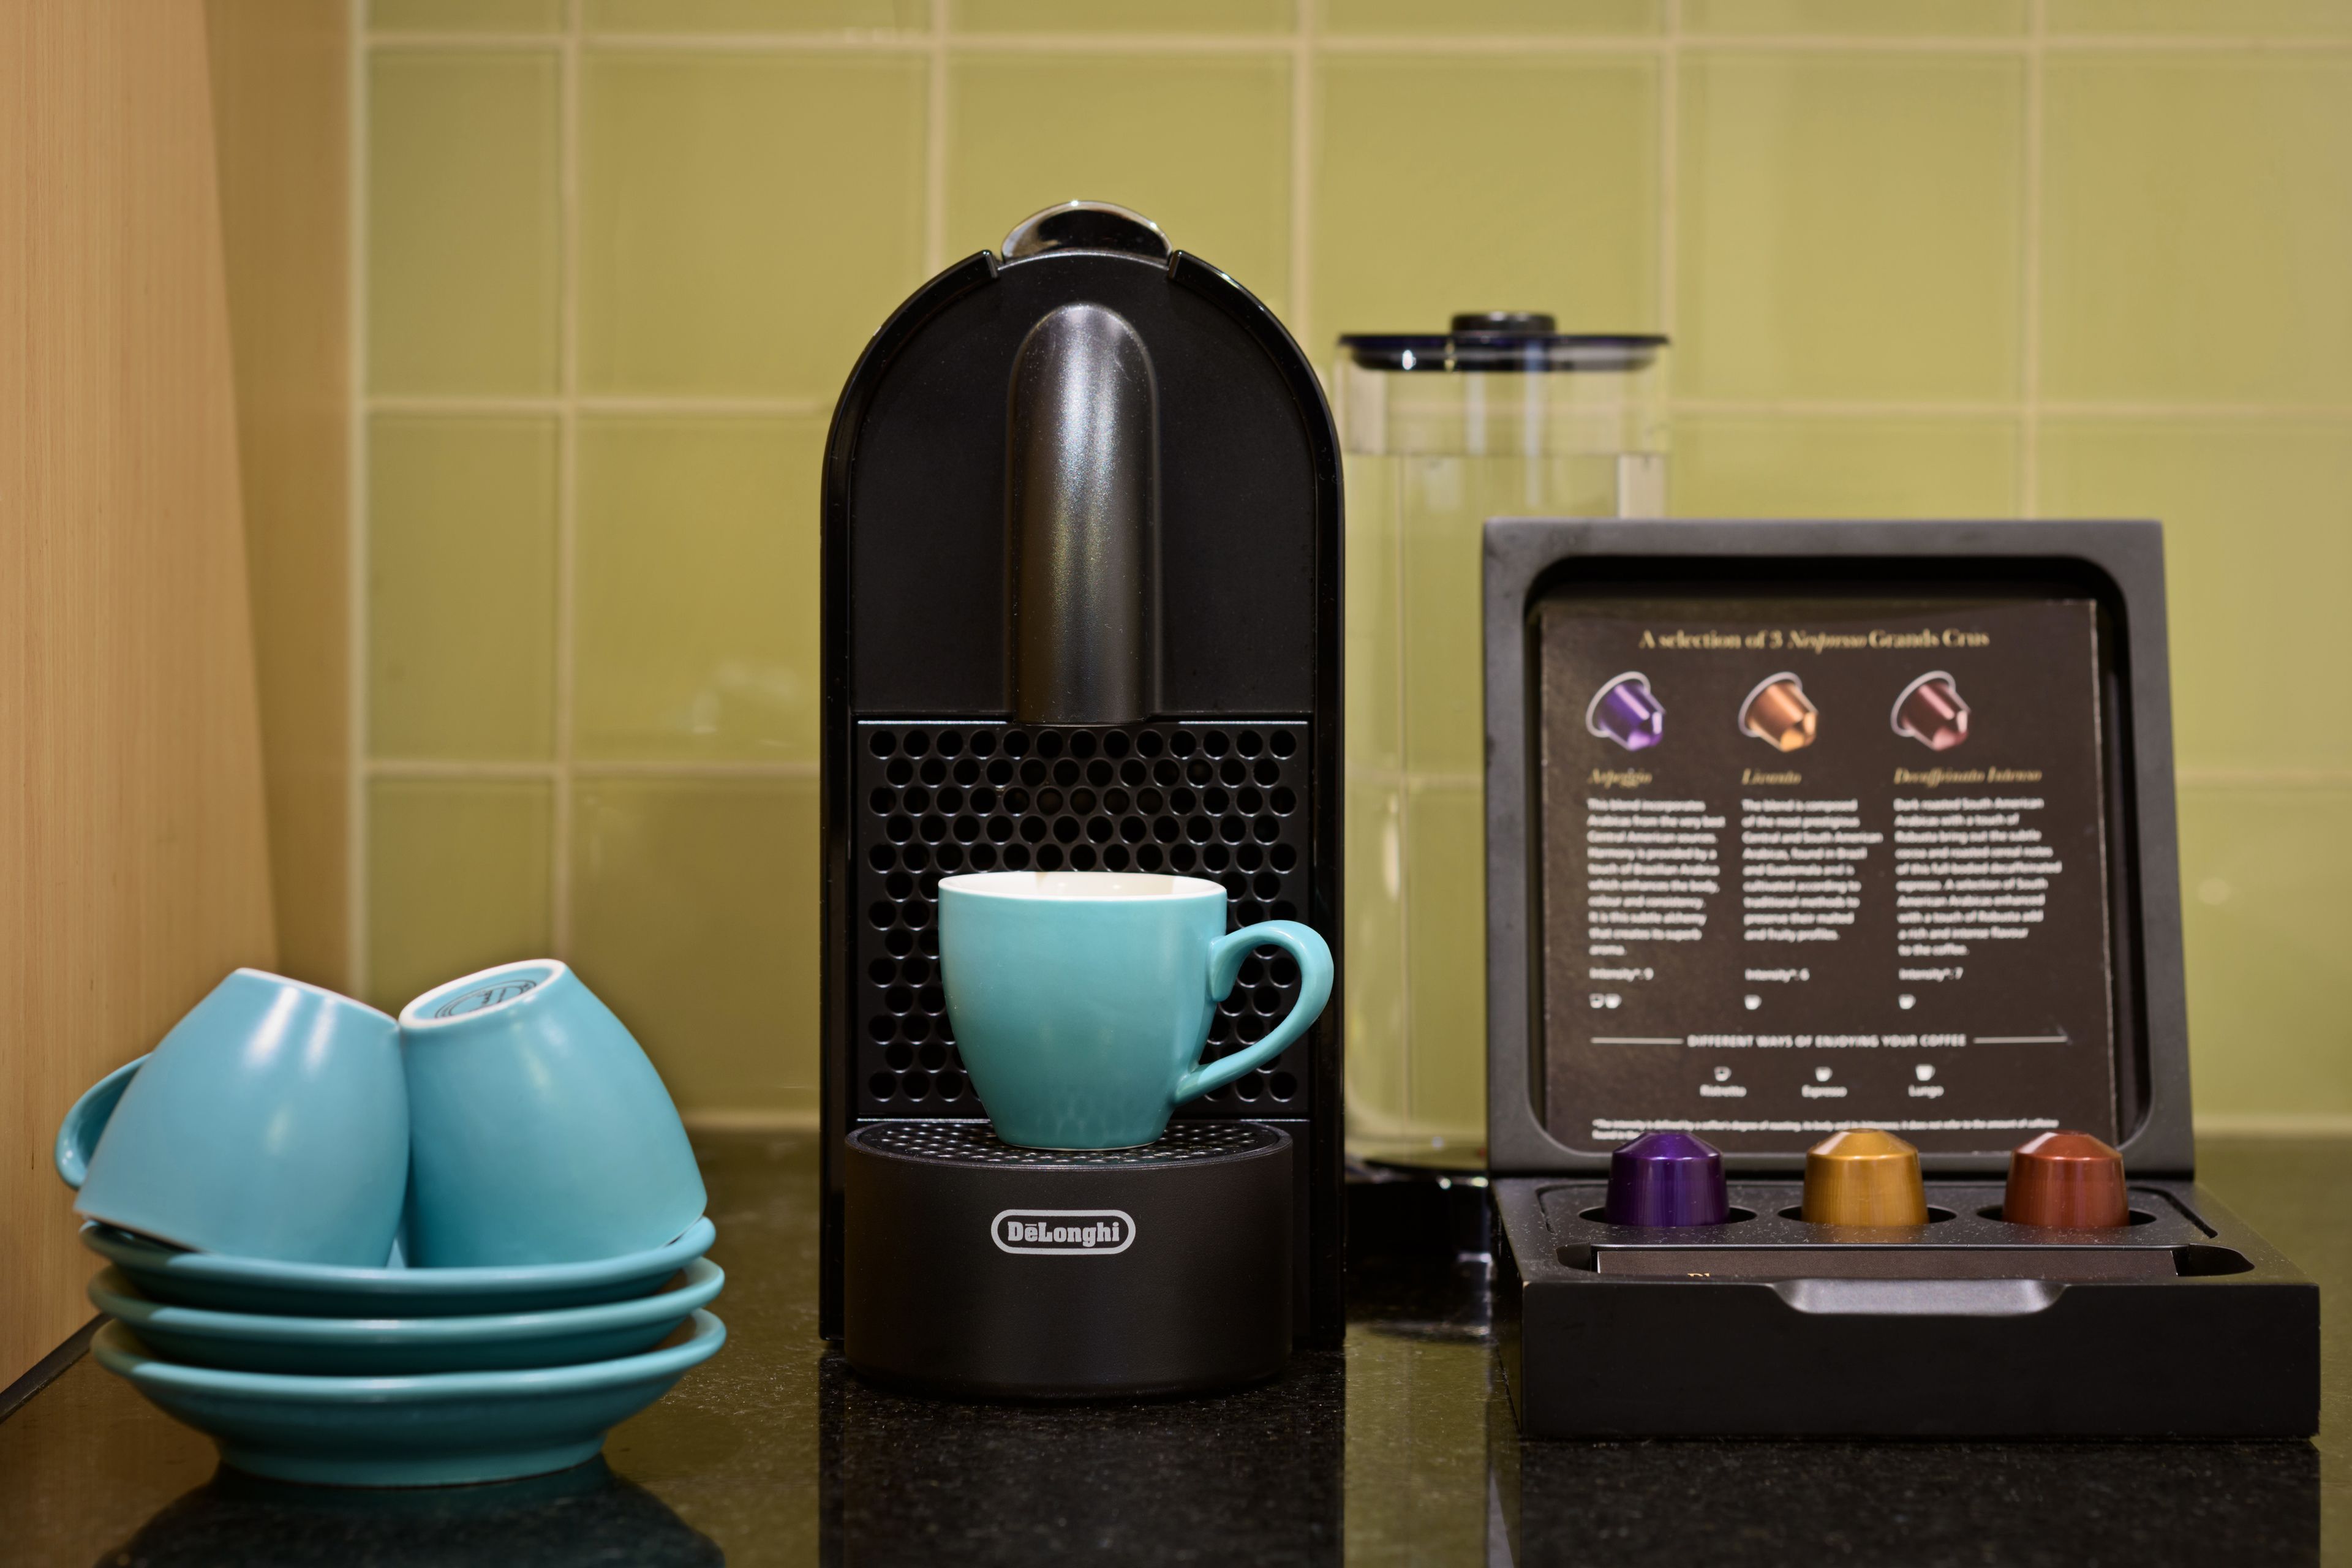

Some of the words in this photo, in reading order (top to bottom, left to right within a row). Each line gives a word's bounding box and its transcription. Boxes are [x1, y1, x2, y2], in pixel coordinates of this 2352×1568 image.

[1640, 632, 1655, 648] A
[1659, 632, 1741, 649] selection
[1744, 631, 1766, 649] of
[1770, 631, 1783, 649] 3
[1785, 630, 1868, 655] Nespresso
[1868, 628, 1940, 649] Grands
[1942, 631, 1989, 647] Crus
[1586, 769, 1653, 788] Arpeggio
[1741, 768, 1801, 785] Livanto
[1687, 1035, 1754, 1047] DIFFERENT
[1756, 1036, 1793, 1047] WAYS
[1795, 1036, 1812, 1047] OF
[1815, 1035, 1879, 1047] ENJOYING
[1882, 1035, 1917, 1047] YOUR
[1920, 1035, 1966, 1047] COFFEE
[1700, 1085, 1746, 1096] Ristretto
[1802, 1085, 1847, 1098] Espresso
[1909, 1086, 1943, 1098] Lungo
